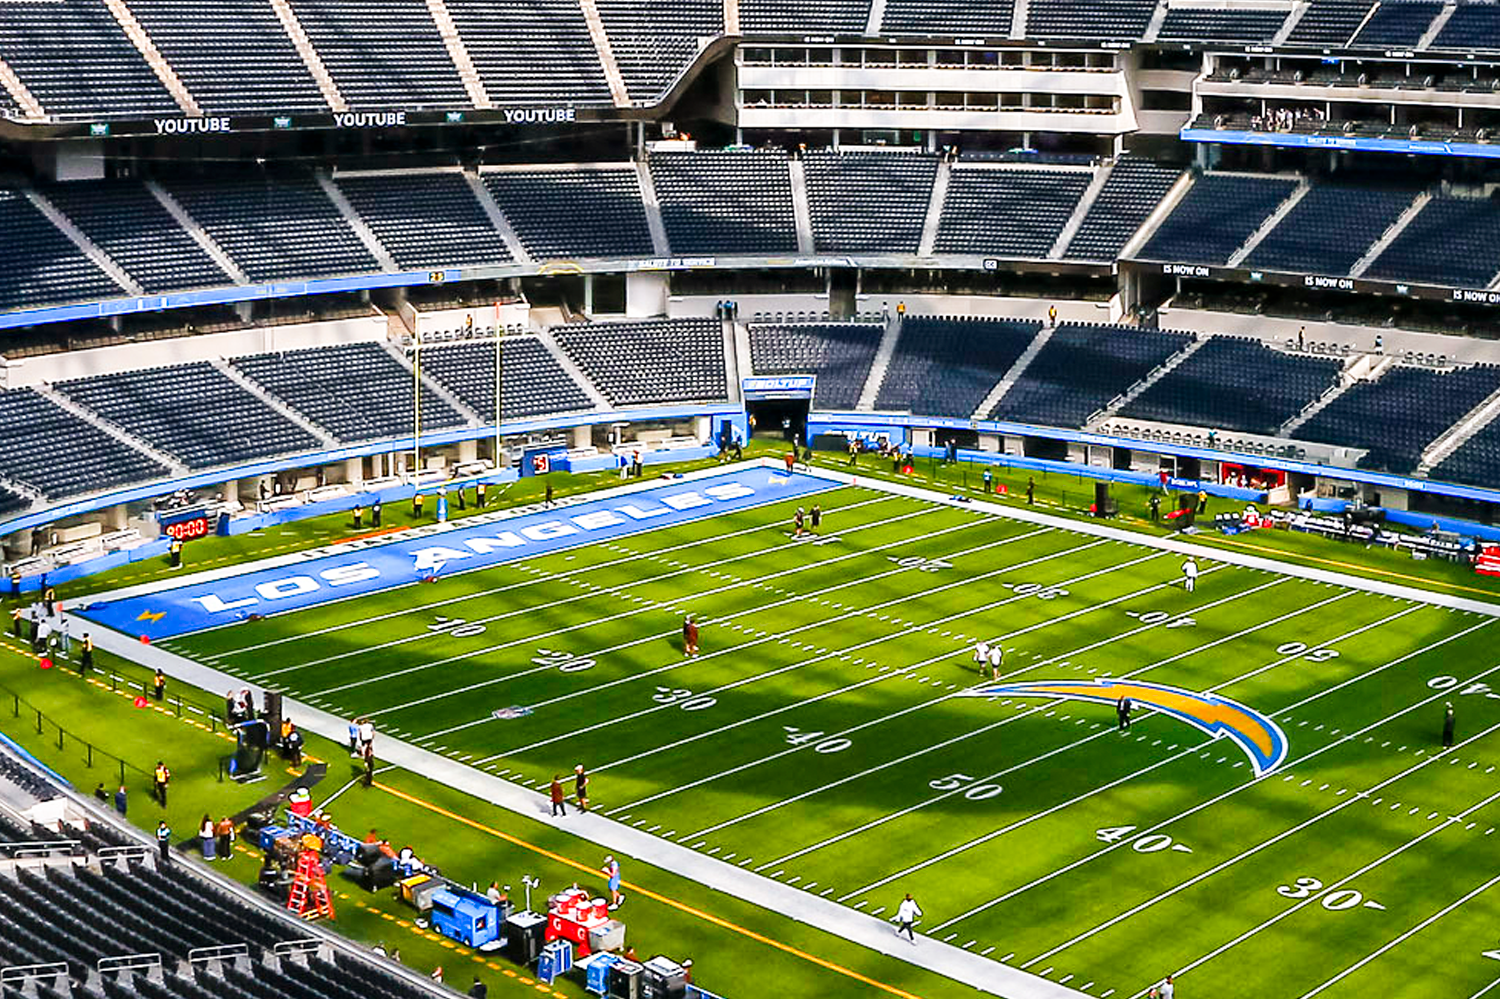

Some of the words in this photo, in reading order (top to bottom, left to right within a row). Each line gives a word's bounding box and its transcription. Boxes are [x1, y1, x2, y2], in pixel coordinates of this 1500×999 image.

[333, 111, 406, 127] YOUTUBE
[504, 109, 575, 124] YOUTUBE
[154, 117, 231, 135] YOUTUBE
[1163, 265, 1172, 274] IS
[1173, 265, 1192, 276] NOW
[1194, 267, 1209, 277] ON
[1304, 276, 1314, 286] IS
[1315, 277, 1338, 288] NOW
[1339, 279, 1353, 289] ON
[1453, 290, 1462, 299] IS
[1463, 291, 1487, 302] NOW
[166, 519, 208, 539] 90:00
[192, 560, 381, 613] LOS
[410, 482, 757, 575] ANGELES
[652, 687, 717, 711] 30
[786, 730, 853, 754] 40
[929, 774, 1004, 802] 50
[1094, 823, 1174, 855] 40
[1276, 876, 1363, 912] 30
[553, 918, 561, 931] G
[577, 928, 586, 940] G
